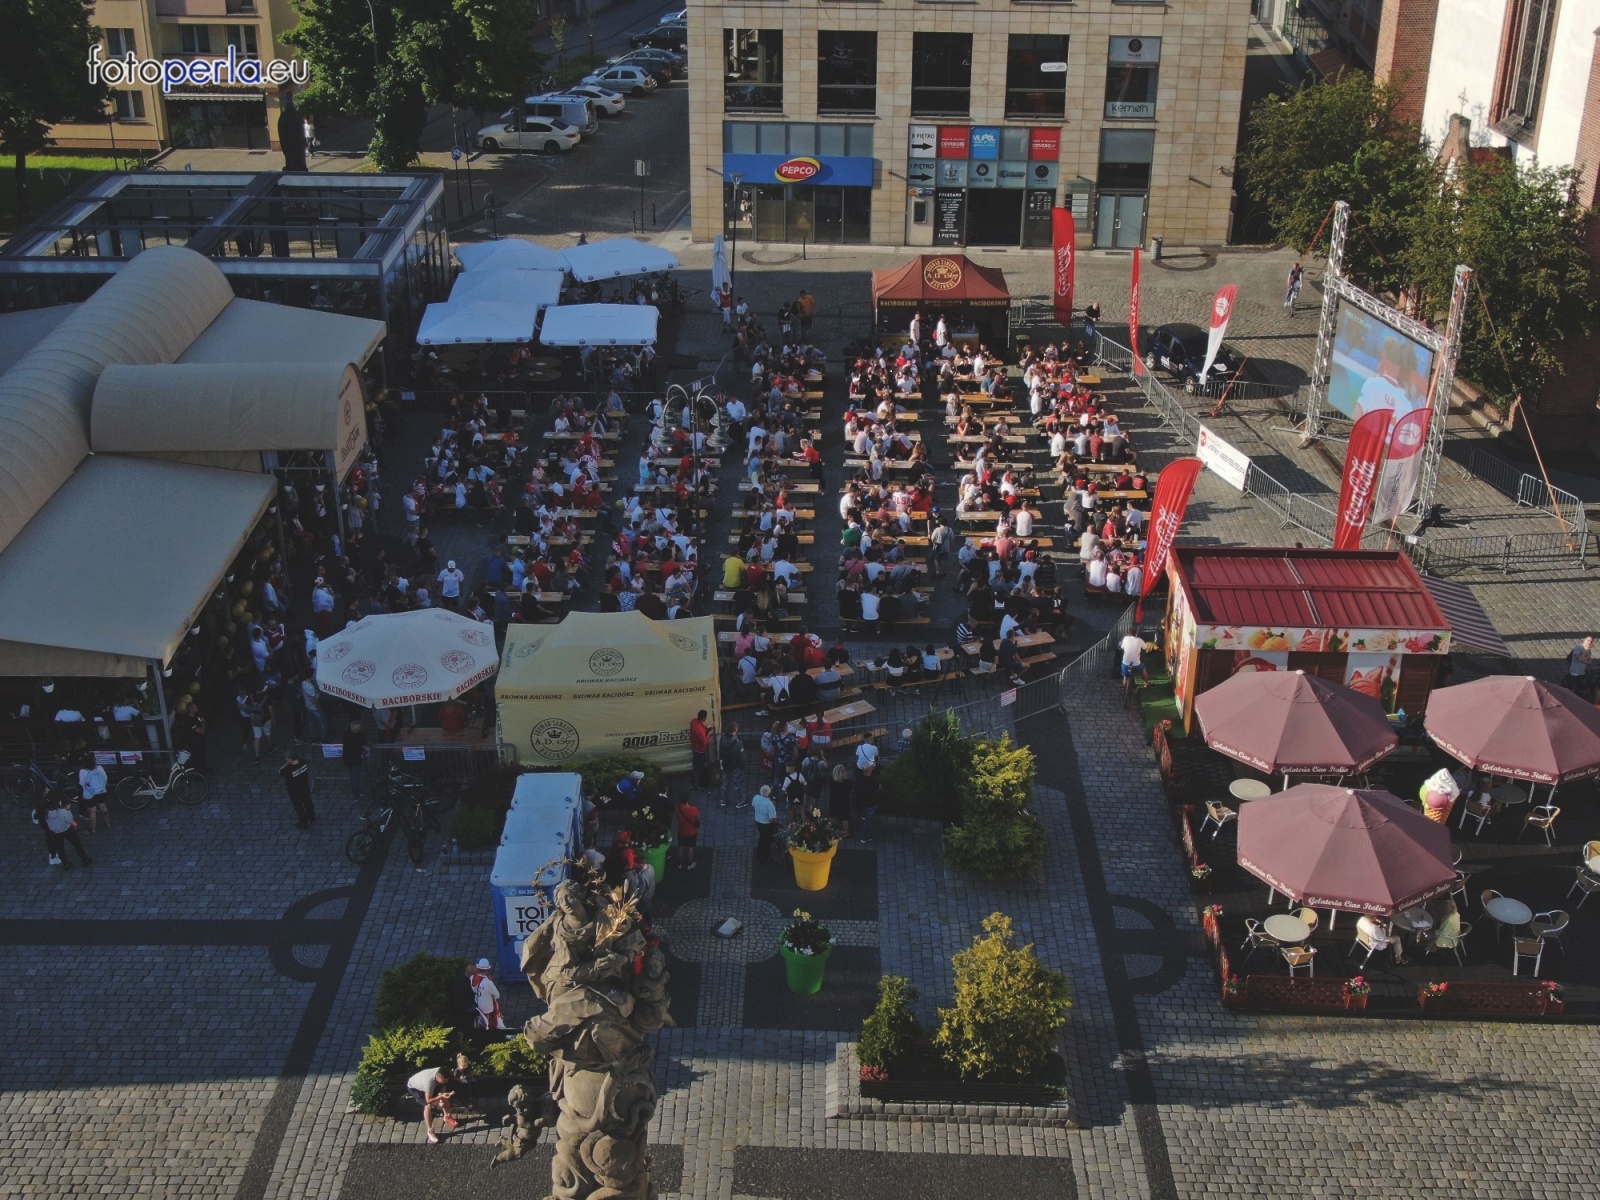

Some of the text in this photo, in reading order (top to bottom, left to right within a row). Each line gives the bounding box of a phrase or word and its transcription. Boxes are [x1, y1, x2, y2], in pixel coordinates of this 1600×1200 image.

[1112, 104, 1148, 113] kemøn
[781, 166, 814, 175] PEPCO
[1208, 444, 1245, 475] VANESSA
[1344, 456, 1376, 528] Coca-Cola
[455, 665, 496, 694] RACIBORSKIE
[323, 683, 367, 704] RACIBORSKIE
[673, 686, 706, 694] RACIBÓRZ
[382, 692, 442, 706] RACIBORSKIE
[1213, 740, 1269, 769] Gelateria Ciao Italia
[1482, 763, 1553, 781] Gelateria Ciao Italia
[1241, 857, 1296, 898] Gelateria Ciao Italia
[515, 906, 545, 919] TOI
[1308, 897, 1387, 912] Gelateria Ciao Italia
[516, 920, 545, 933] TO
